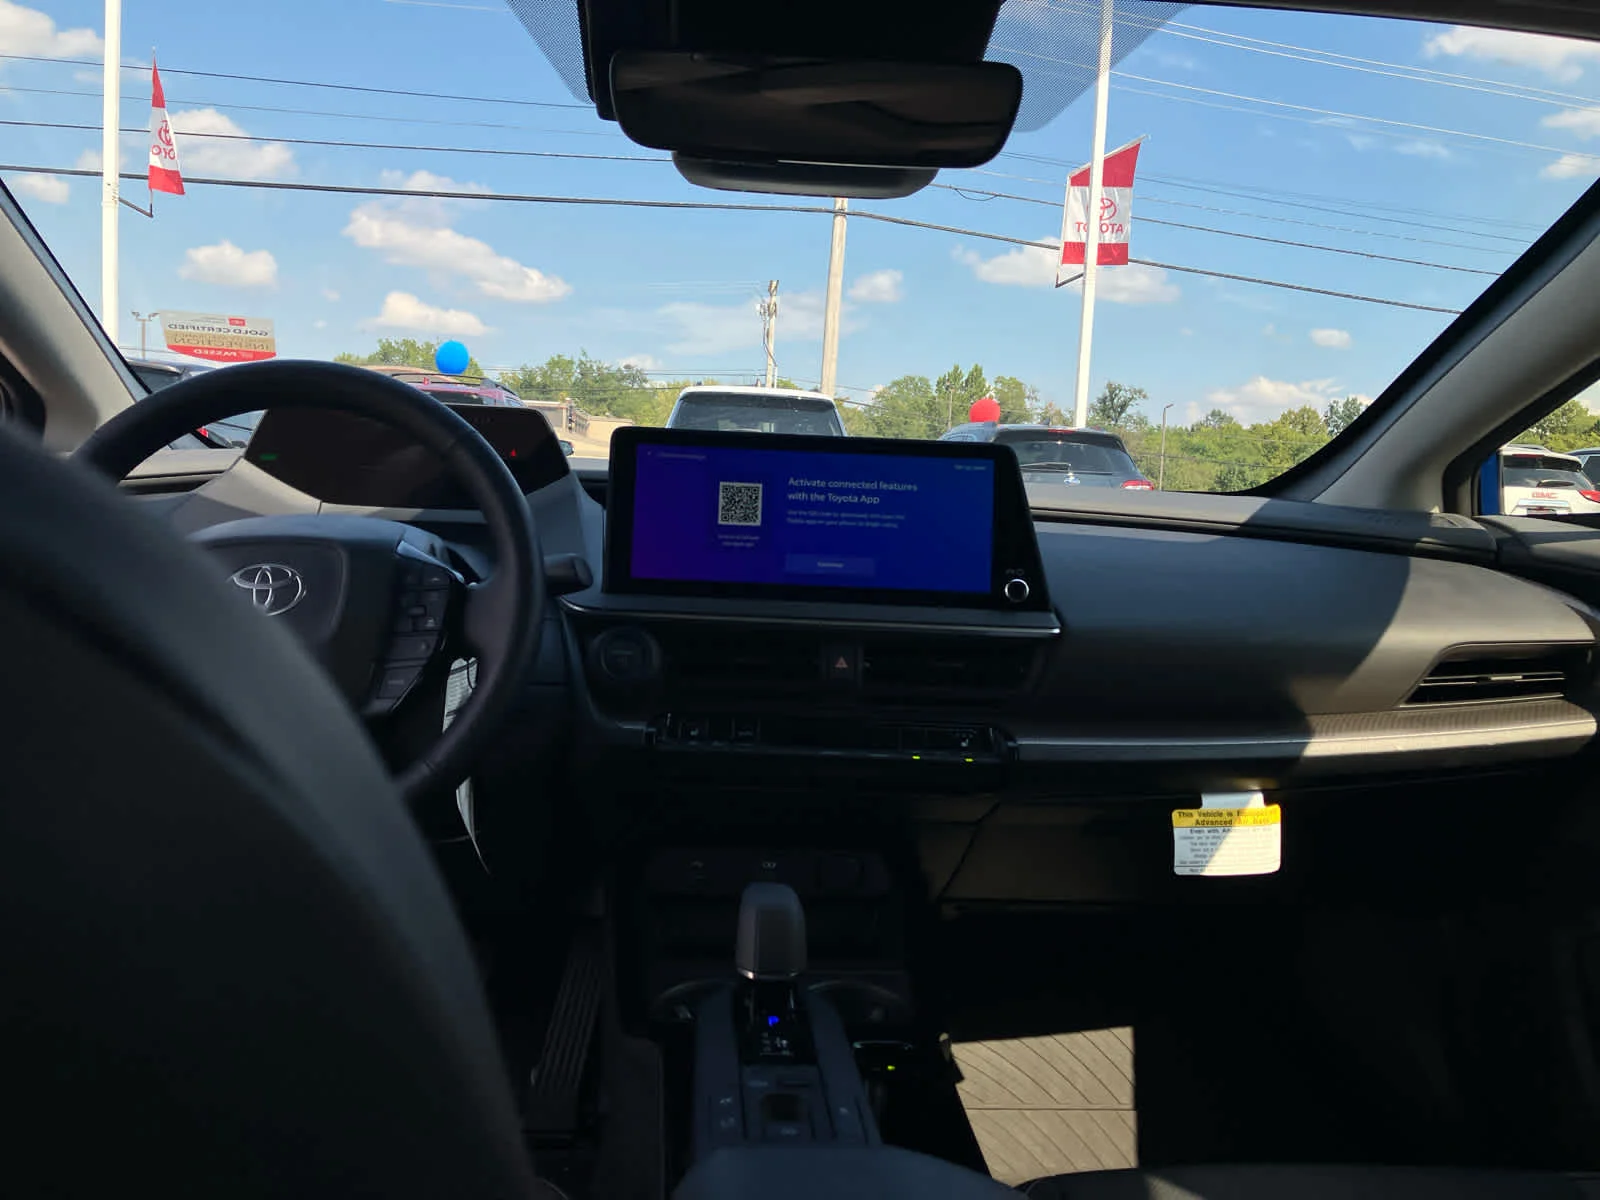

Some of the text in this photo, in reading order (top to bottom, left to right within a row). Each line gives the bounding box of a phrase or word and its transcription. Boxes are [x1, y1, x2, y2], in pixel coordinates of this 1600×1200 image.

[1075, 222, 1124, 234] TOOTA
[788, 477, 918, 491] Activate connected features
[787, 491, 880, 504] with the Toyota App
